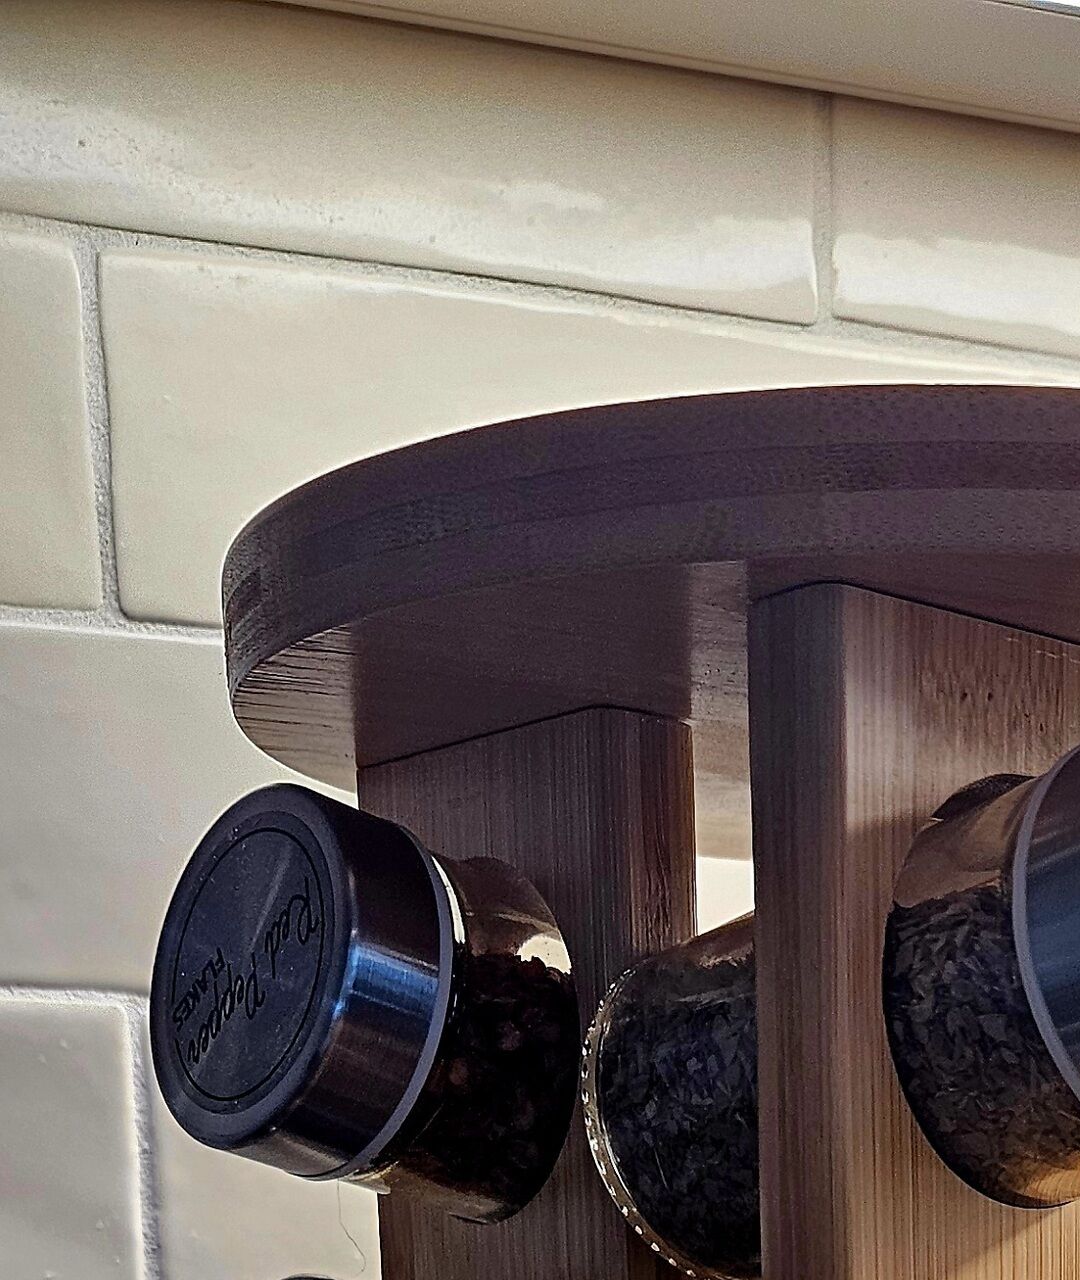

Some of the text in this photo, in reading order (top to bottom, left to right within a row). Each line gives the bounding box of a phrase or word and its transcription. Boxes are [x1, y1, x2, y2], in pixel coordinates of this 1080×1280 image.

[173, 947, 224, 1032] FLAKES
[188, 877, 319, 1064] Red Pepper
